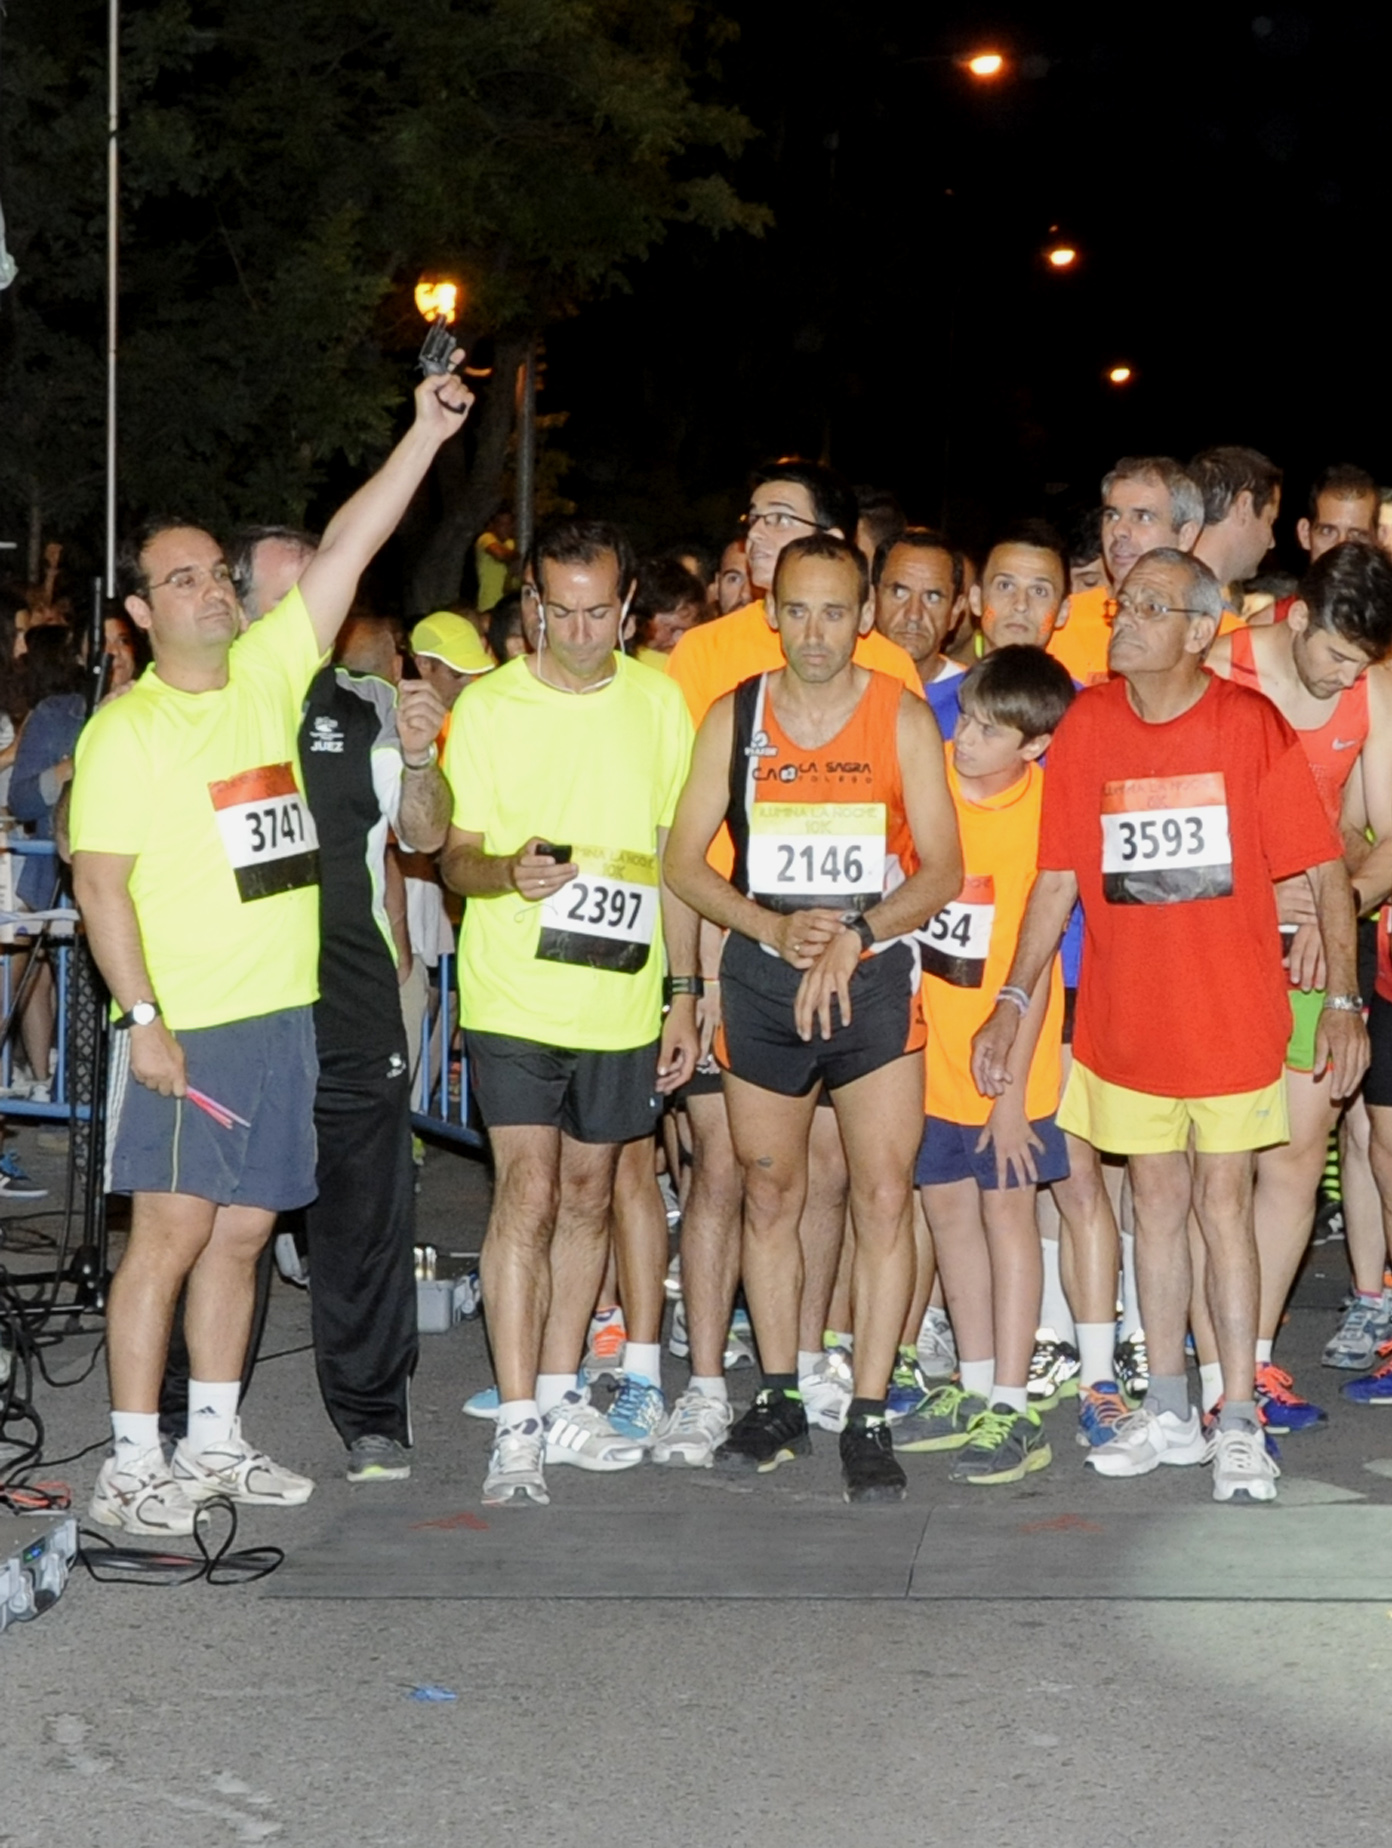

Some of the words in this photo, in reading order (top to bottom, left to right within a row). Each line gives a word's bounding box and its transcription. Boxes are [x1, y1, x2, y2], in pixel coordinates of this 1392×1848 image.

[798, 762, 818, 773] LA
[825, 762, 872, 773] SAGRA
[245, 803, 304, 853] 3747
[804, 819, 832, 834] 10K
[811, 807, 830, 819] LA
[1119, 816, 1205, 861] 3593
[777, 844, 863, 883] 2146
[567, 883, 642, 930] 2397
